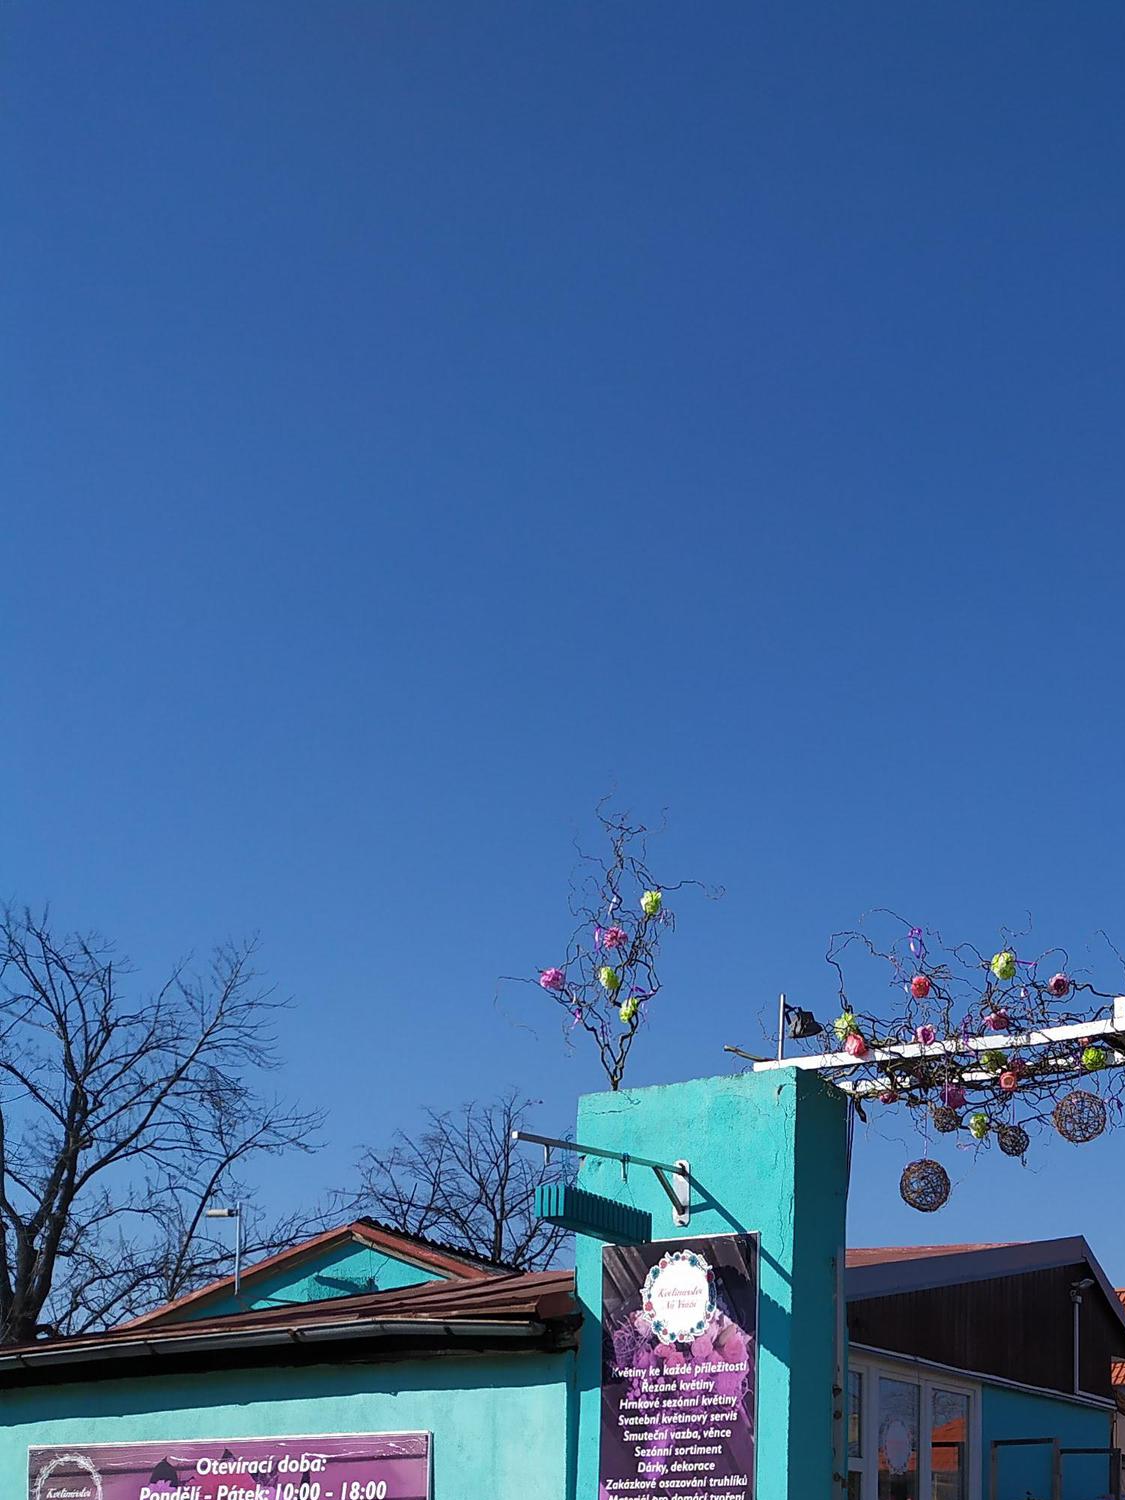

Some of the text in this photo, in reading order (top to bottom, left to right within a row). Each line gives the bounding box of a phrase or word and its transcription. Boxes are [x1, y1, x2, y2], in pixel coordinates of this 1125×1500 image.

[611, 1366, 647, 1379] Květiny
[649, 1366, 661, 1377] ke
[663, 1363, 692, 1376] každé
[641, 1379, 715, 1393] Řezané květiny
[619, 1395, 738, 1410] Hrnkové sezónní květiny
[618, 1411, 738, 1426] Svatební květinový servis
[623, 1428, 732, 1442] Smuteční vazba, věnce
[634, 1444, 722, 1457] Sezónní sortiment
[196, 1453, 327, 1475] Otevírací doba:
[637, 1461, 715, 1475] Dárky, dekorace
[606, 1474, 748, 1490] Zakázkové osazování truhlíků
[341, 1480, 387, 1500] 18:00
